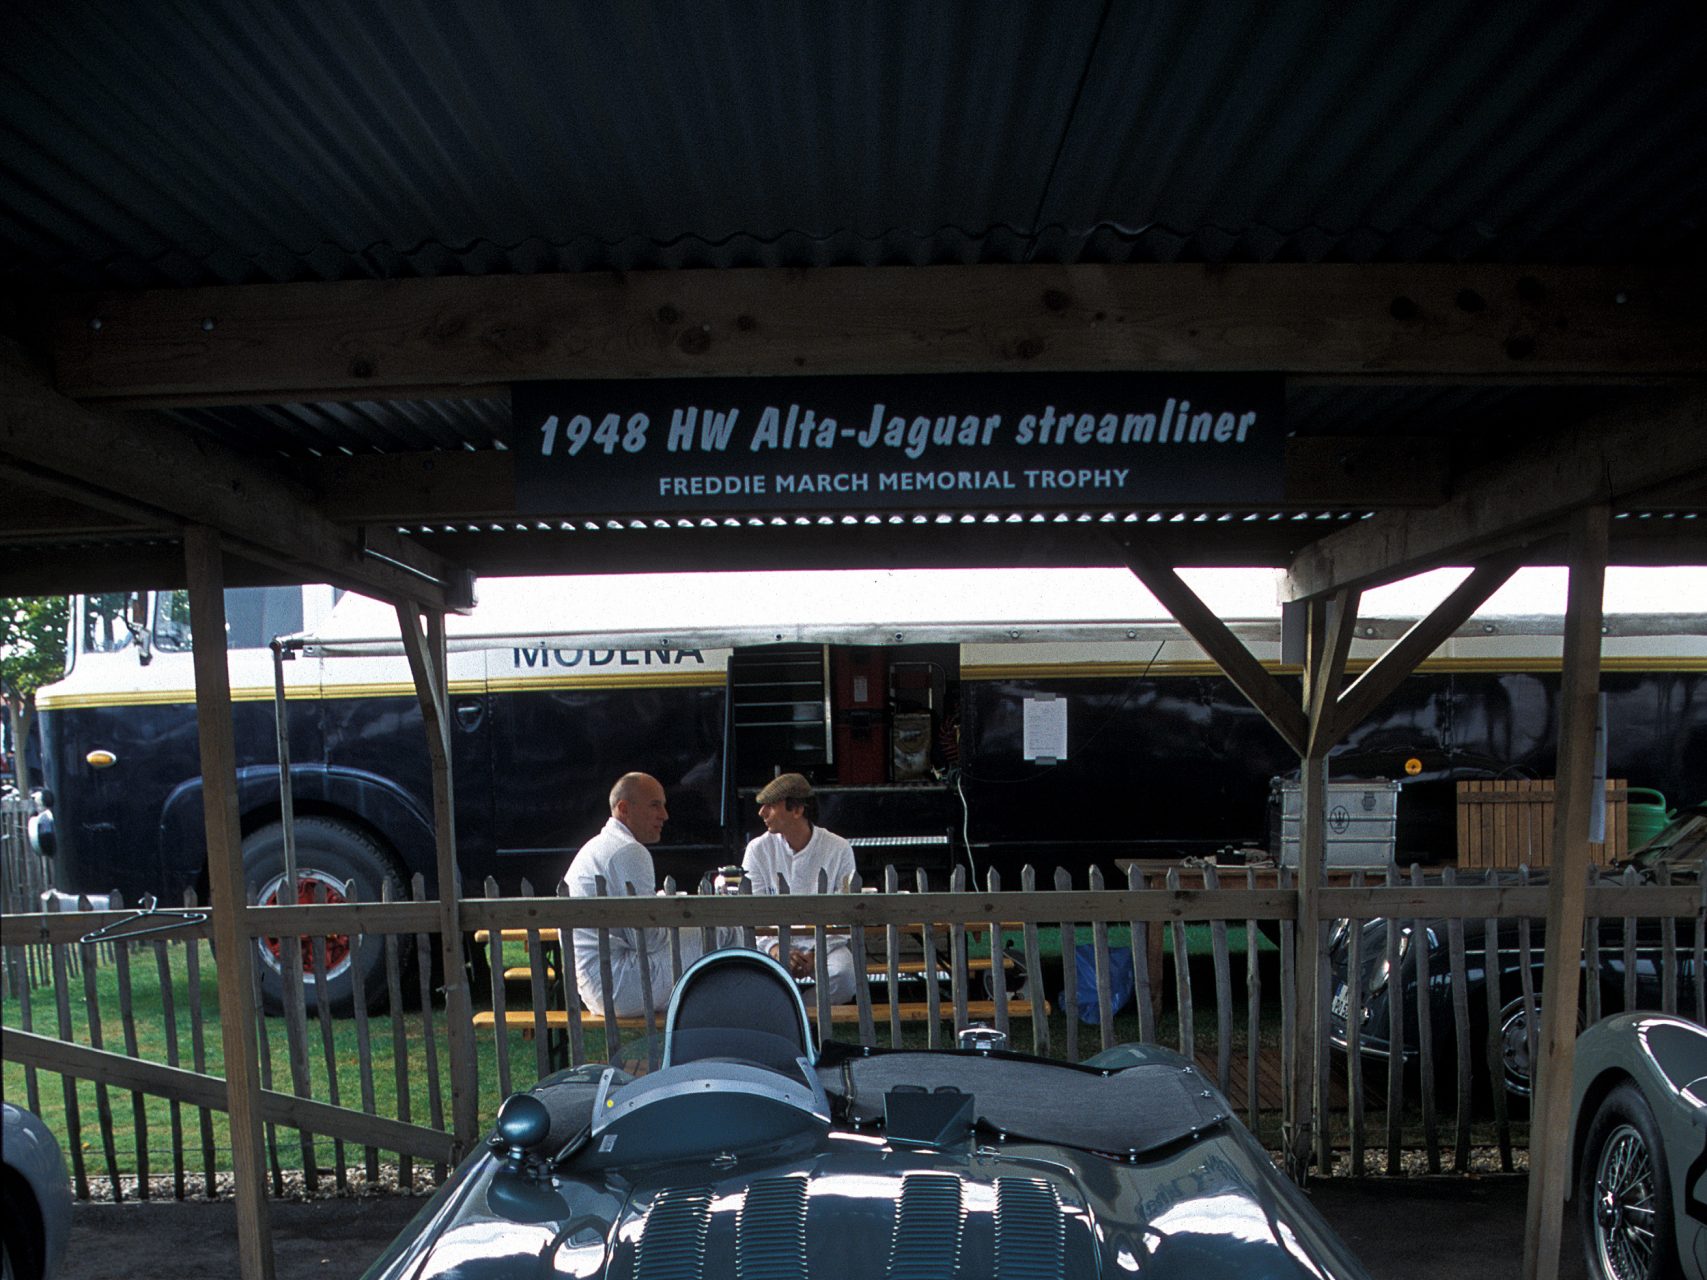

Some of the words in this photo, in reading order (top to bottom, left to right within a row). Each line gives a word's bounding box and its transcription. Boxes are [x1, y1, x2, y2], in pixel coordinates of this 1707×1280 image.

[541, 412, 650, 456] 1948
[667, 406, 739, 452] HW
[749, 403, 1001, 459] Alta-Jaguar
[1015, 398, 1256, 445] streamliner
[659, 474, 766, 496] FREDDIE
[775, 472, 869, 494] MARCH
[878, 470, 1016, 491] MEMORIAL
[1023, 468, 1130, 489] TROPHY
